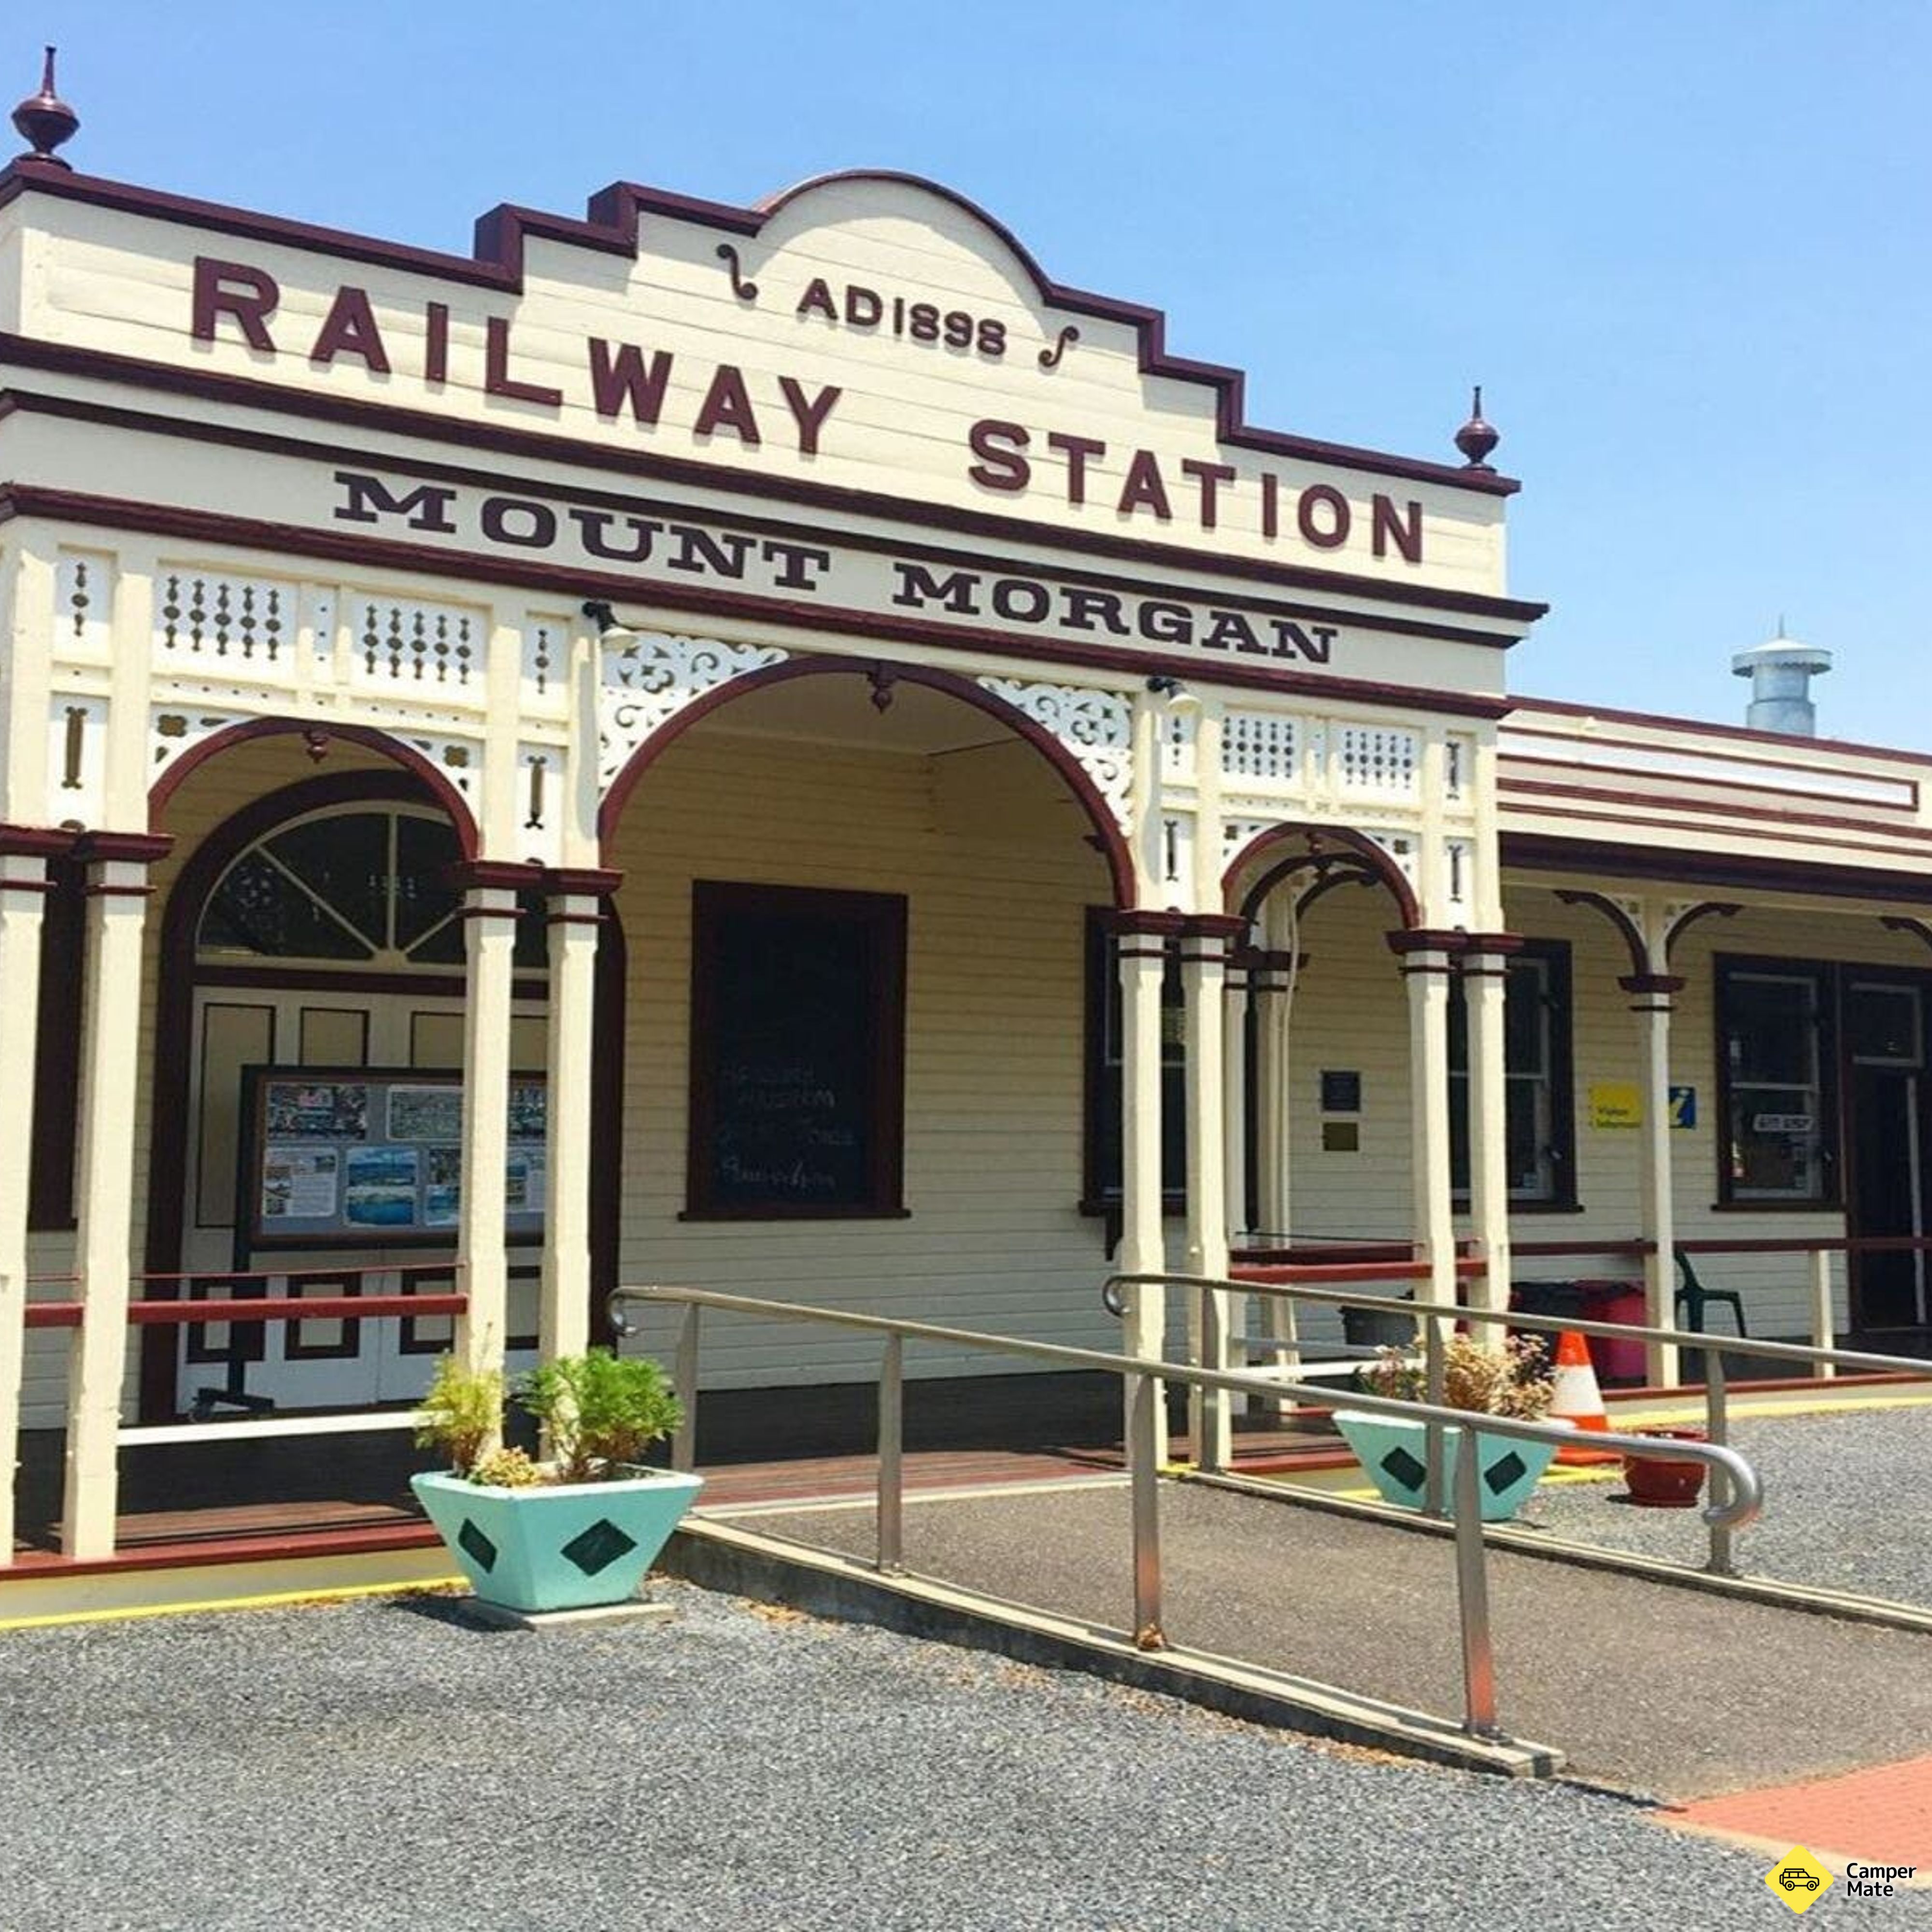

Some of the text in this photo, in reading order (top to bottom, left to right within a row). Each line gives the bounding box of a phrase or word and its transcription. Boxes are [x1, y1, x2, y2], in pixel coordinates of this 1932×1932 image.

[189, 256, 1422, 564] RAILWAY STATION
[333, 470, 1338, 664] MOUNT MORGAN
